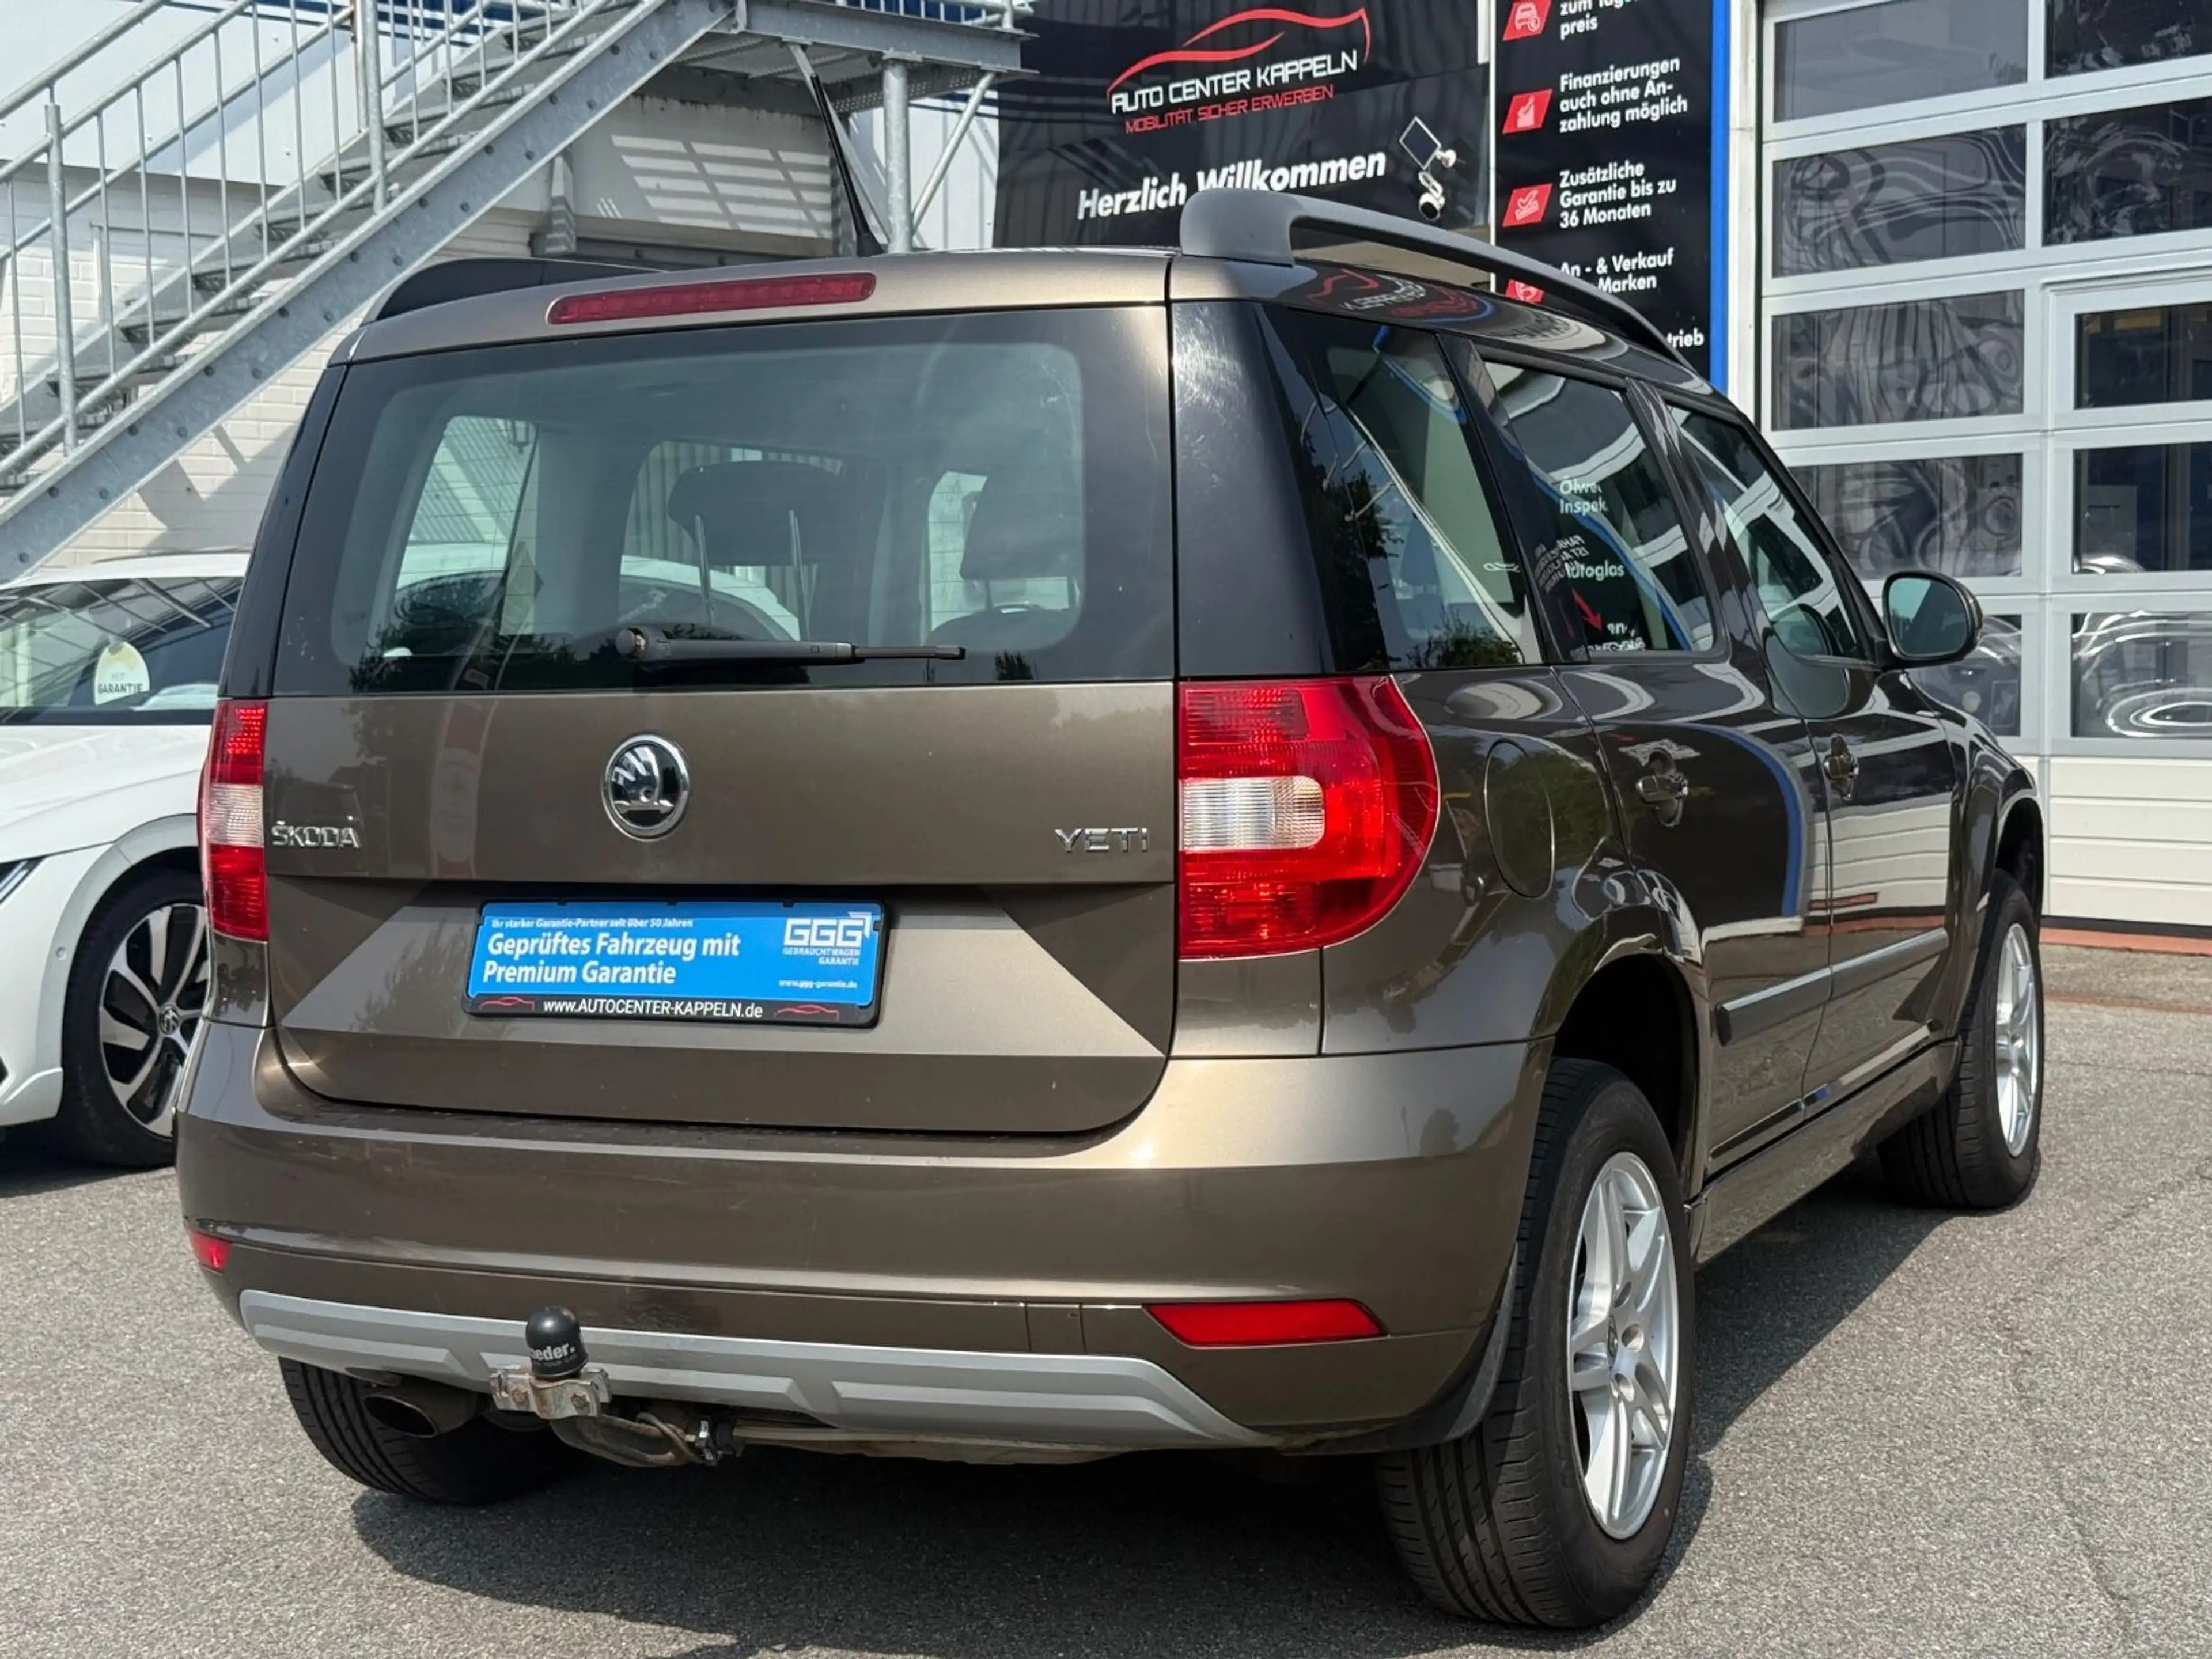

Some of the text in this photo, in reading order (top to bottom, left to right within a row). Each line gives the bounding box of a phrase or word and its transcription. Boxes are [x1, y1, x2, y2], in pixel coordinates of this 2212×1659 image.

[1560, 0, 1592, 16] zum
[1560, 13, 1598, 40] preis
[1111, 50, 1358, 115] AUTO CENTER KAPPELN
[1560, 57, 1680, 92] Finanzierungen
[1124, 84, 1334, 134] MOBILITÄT SICHER ERWERBEN
[1559, 79, 1674, 113] auch ohne An-
[1559, 96, 1688, 133] zahlung möglich
[1078, 151, 1387, 221] Herzlich Willkommen
[1559, 160, 1645, 189] Zusätzliche
[1559, 179, 1677, 209] Garantie bis zu
[1559, 202, 1652, 229] 36 Monaten
[1560, 261, 1581, 278] An
[1596, 257, 1608, 275] &
[1611, 248, 1675, 273] Verkauf
[1597, 273, 1657, 294] Marken
[487, 932, 741, 962] Geprüftes Fahrzeug mit
[784, 918, 864, 948] GGG
[483, 960, 677, 984] Premium Garantie
[818, 956, 859, 966] GARANTIE
[543, 998, 763, 1018] www.AUTOCENTER-KAPPELN.de
